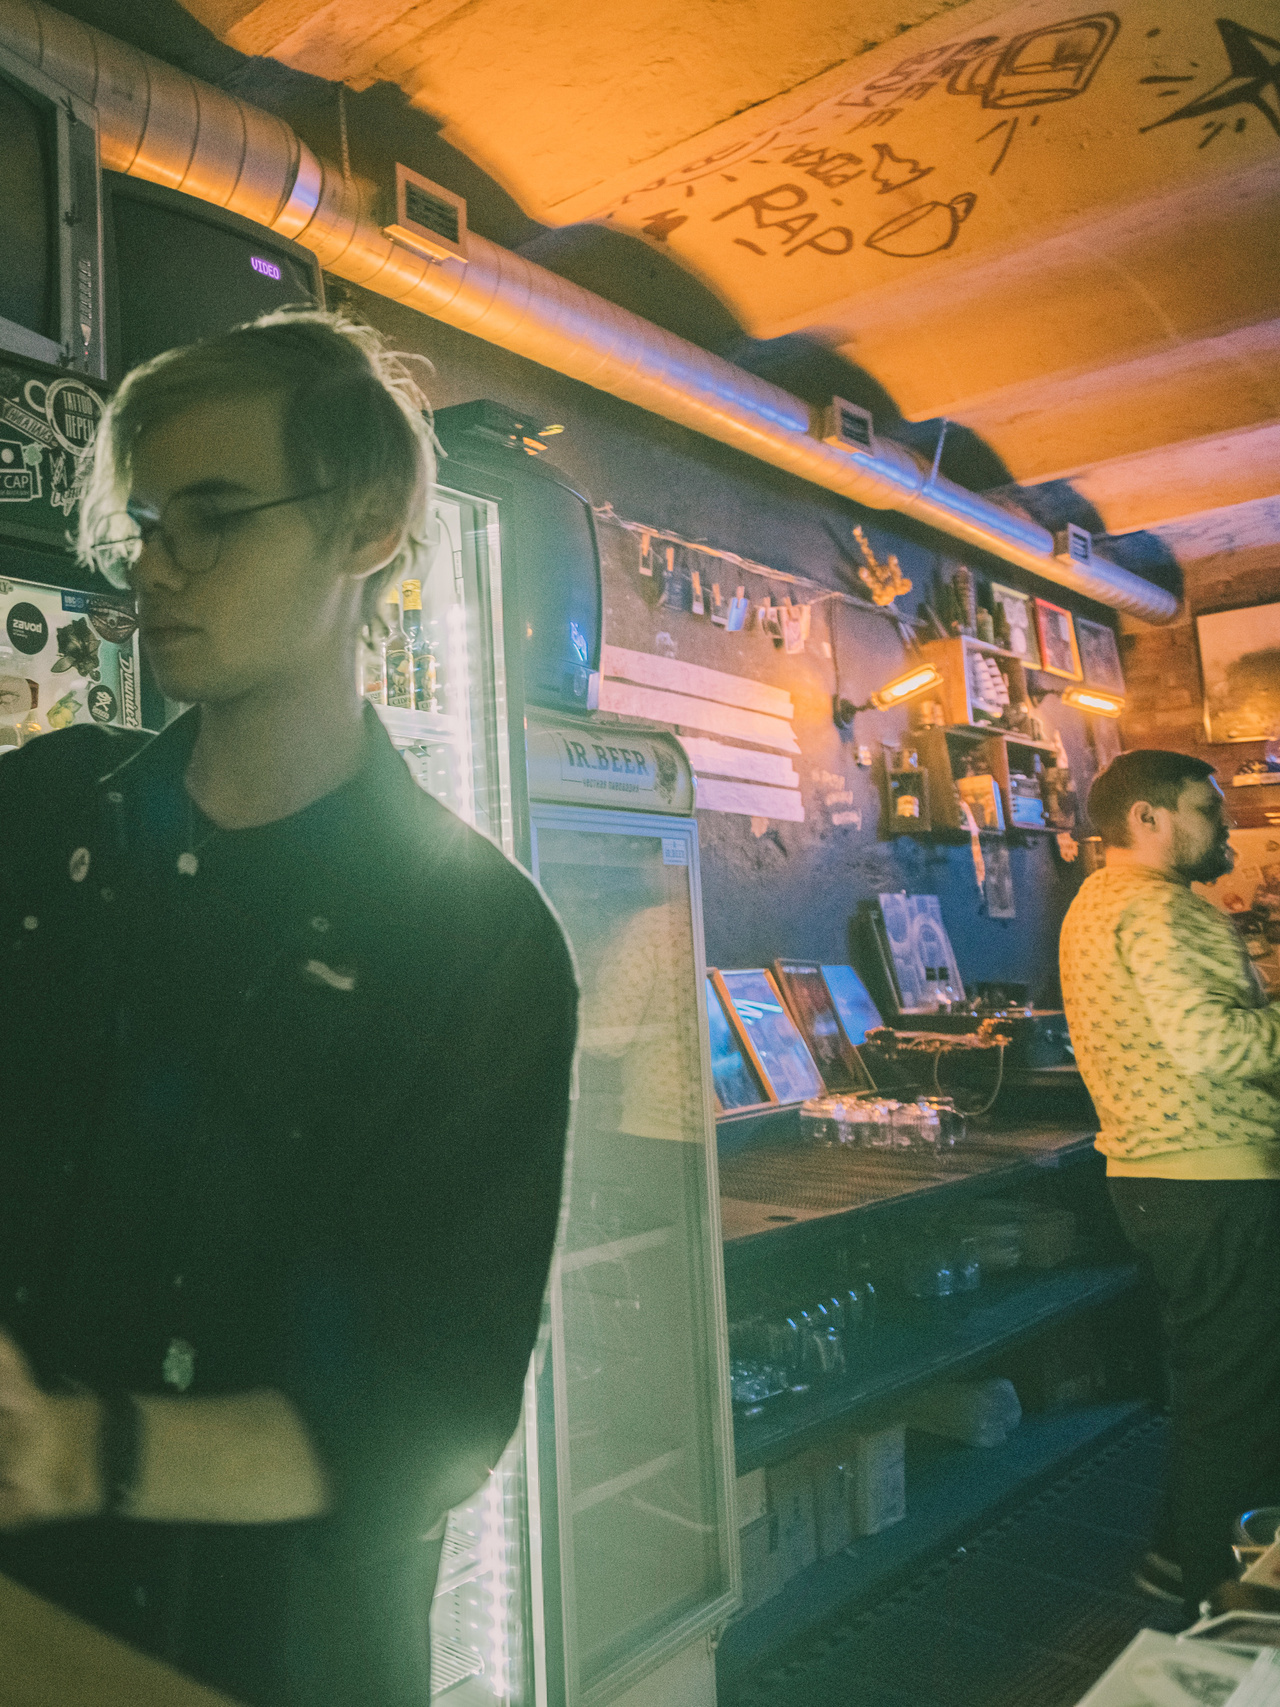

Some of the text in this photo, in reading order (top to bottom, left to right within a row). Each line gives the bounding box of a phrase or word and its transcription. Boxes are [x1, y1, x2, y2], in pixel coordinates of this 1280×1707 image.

[712, 183, 854, 257] RAP
[250, 256, 281, 280] VIDEO
[4, 474, 29, 489] CAP
[12, 618, 43, 633] zavod
